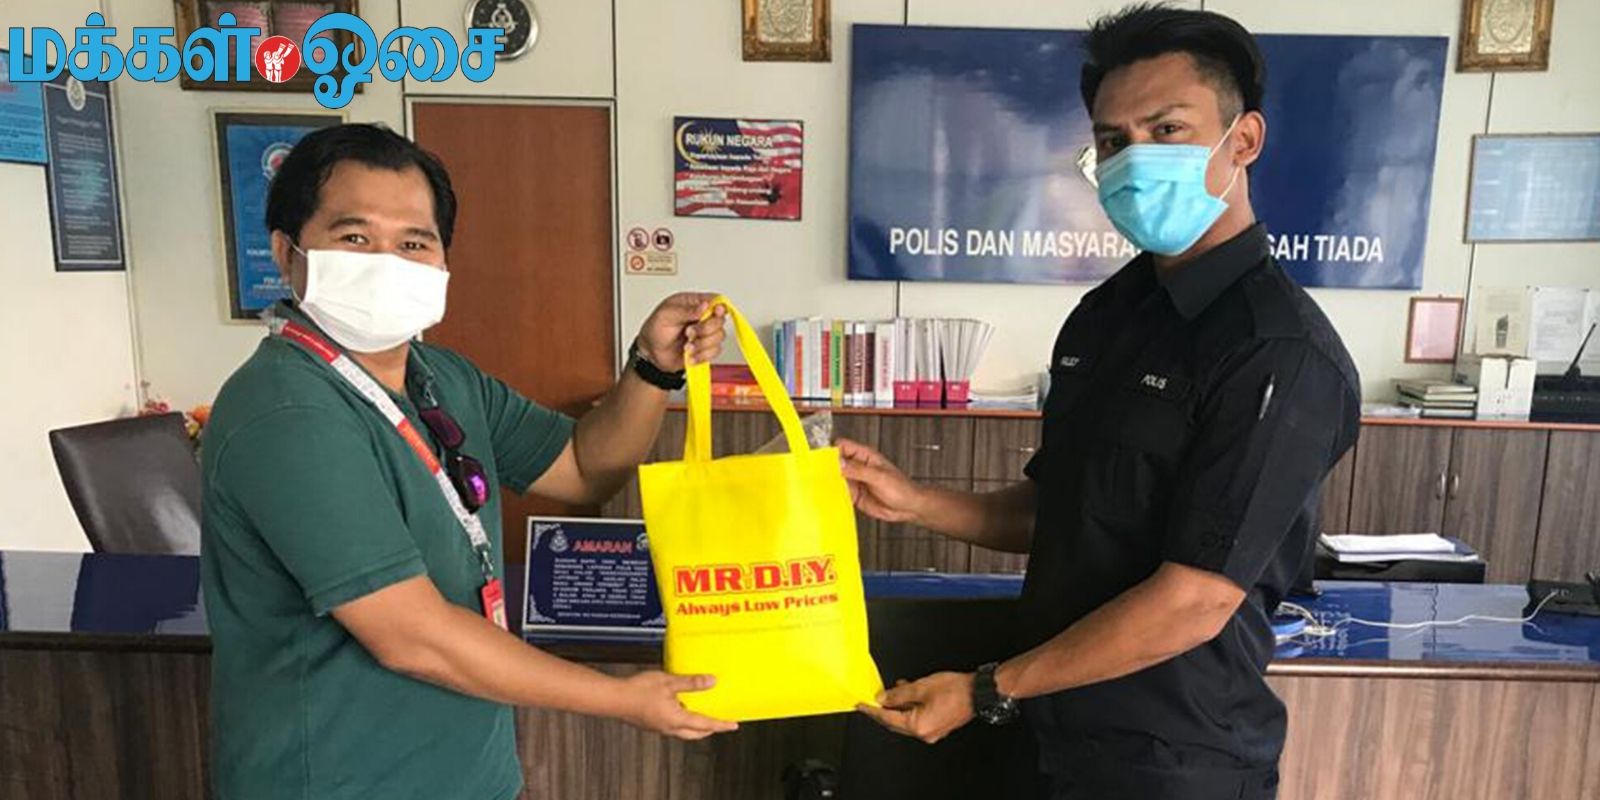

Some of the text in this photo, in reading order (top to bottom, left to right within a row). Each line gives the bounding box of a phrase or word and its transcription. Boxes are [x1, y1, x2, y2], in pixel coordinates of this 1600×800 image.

[685, 133, 773, 149] RUKUN NEGARA
[889, 228, 1384, 263] POLIS DAN MASYARA SAH TIADA
[573, 540, 633, 554] AMARAN
[675, 566, 743, 594] MR
[676, 593, 838, 616] Always Low Prices
